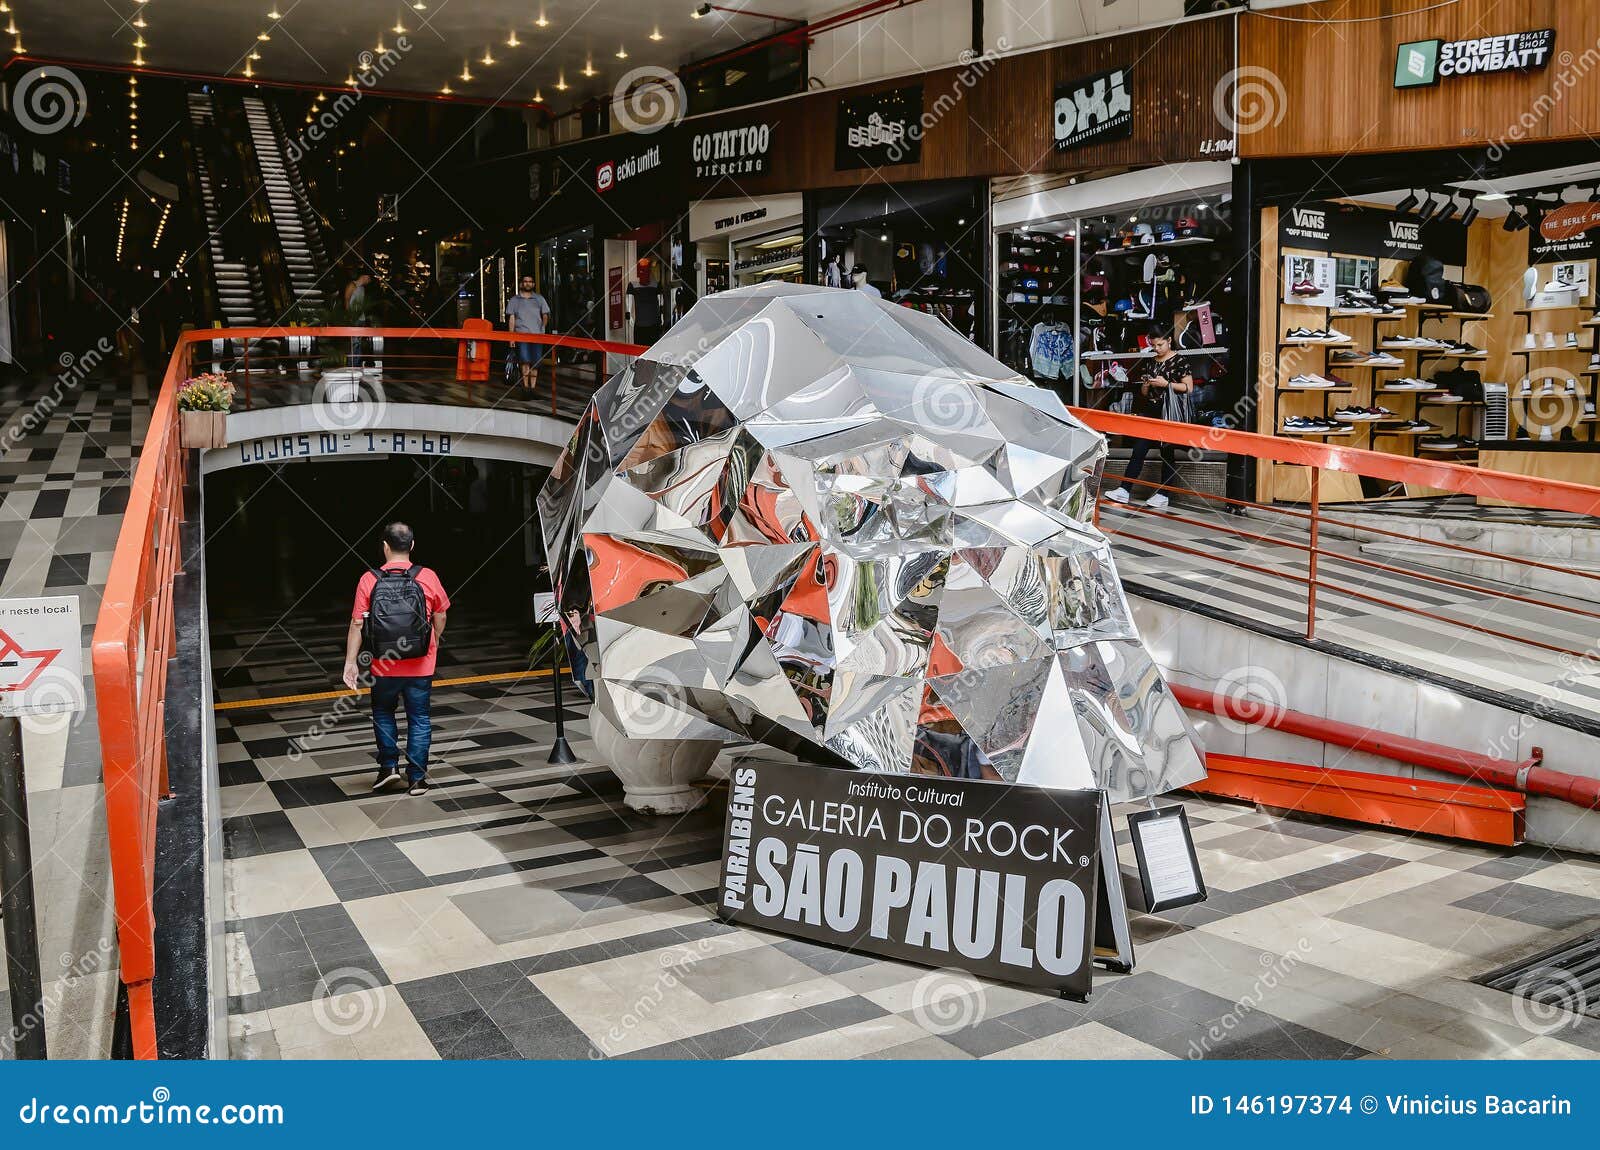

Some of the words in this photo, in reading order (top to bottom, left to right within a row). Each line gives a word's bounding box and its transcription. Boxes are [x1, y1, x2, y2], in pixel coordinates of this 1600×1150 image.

[1440, 33, 1520, 60] STREET
[1519, 38, 1546, 50] SHOP
[1520, 30, 1550, 41] SKATE
[1438, 47, 1548, 77] COMBATT
[692, 133, 711, 163] GO
[711, 123, 770, 161] TATTOO
[696, 159, 762, 178] PIERCING
[714, 216, 735, 230] TATTOO
[740, 207, 767, 223] PIERCING
[1292, 207, 1326, 230] VANS
[1544, 220, 1558, 230] THE
[1300, 229, 1313, 238] THE
[1389, 220, 1419, 241] VANS
[1396, 241, 1408, 249] THE
[1552, 243, 1568, 252] THE
[240, 434, 310, 464] LOJAS
[9, 606, 40, 615] neste
[43, 604, 72, 614] local.
[848, 780, 901, 799] Instituto
[905, 785, 964, 807] Cultural
[723, 767, 757, 911] PARABÉNS
[762, 794, 887, 841] GALERIA
[897, 810, 952, 848] DO
[964, 817, 1074, 865] ROCK
[870, 854, 1086, 976] PAULO
